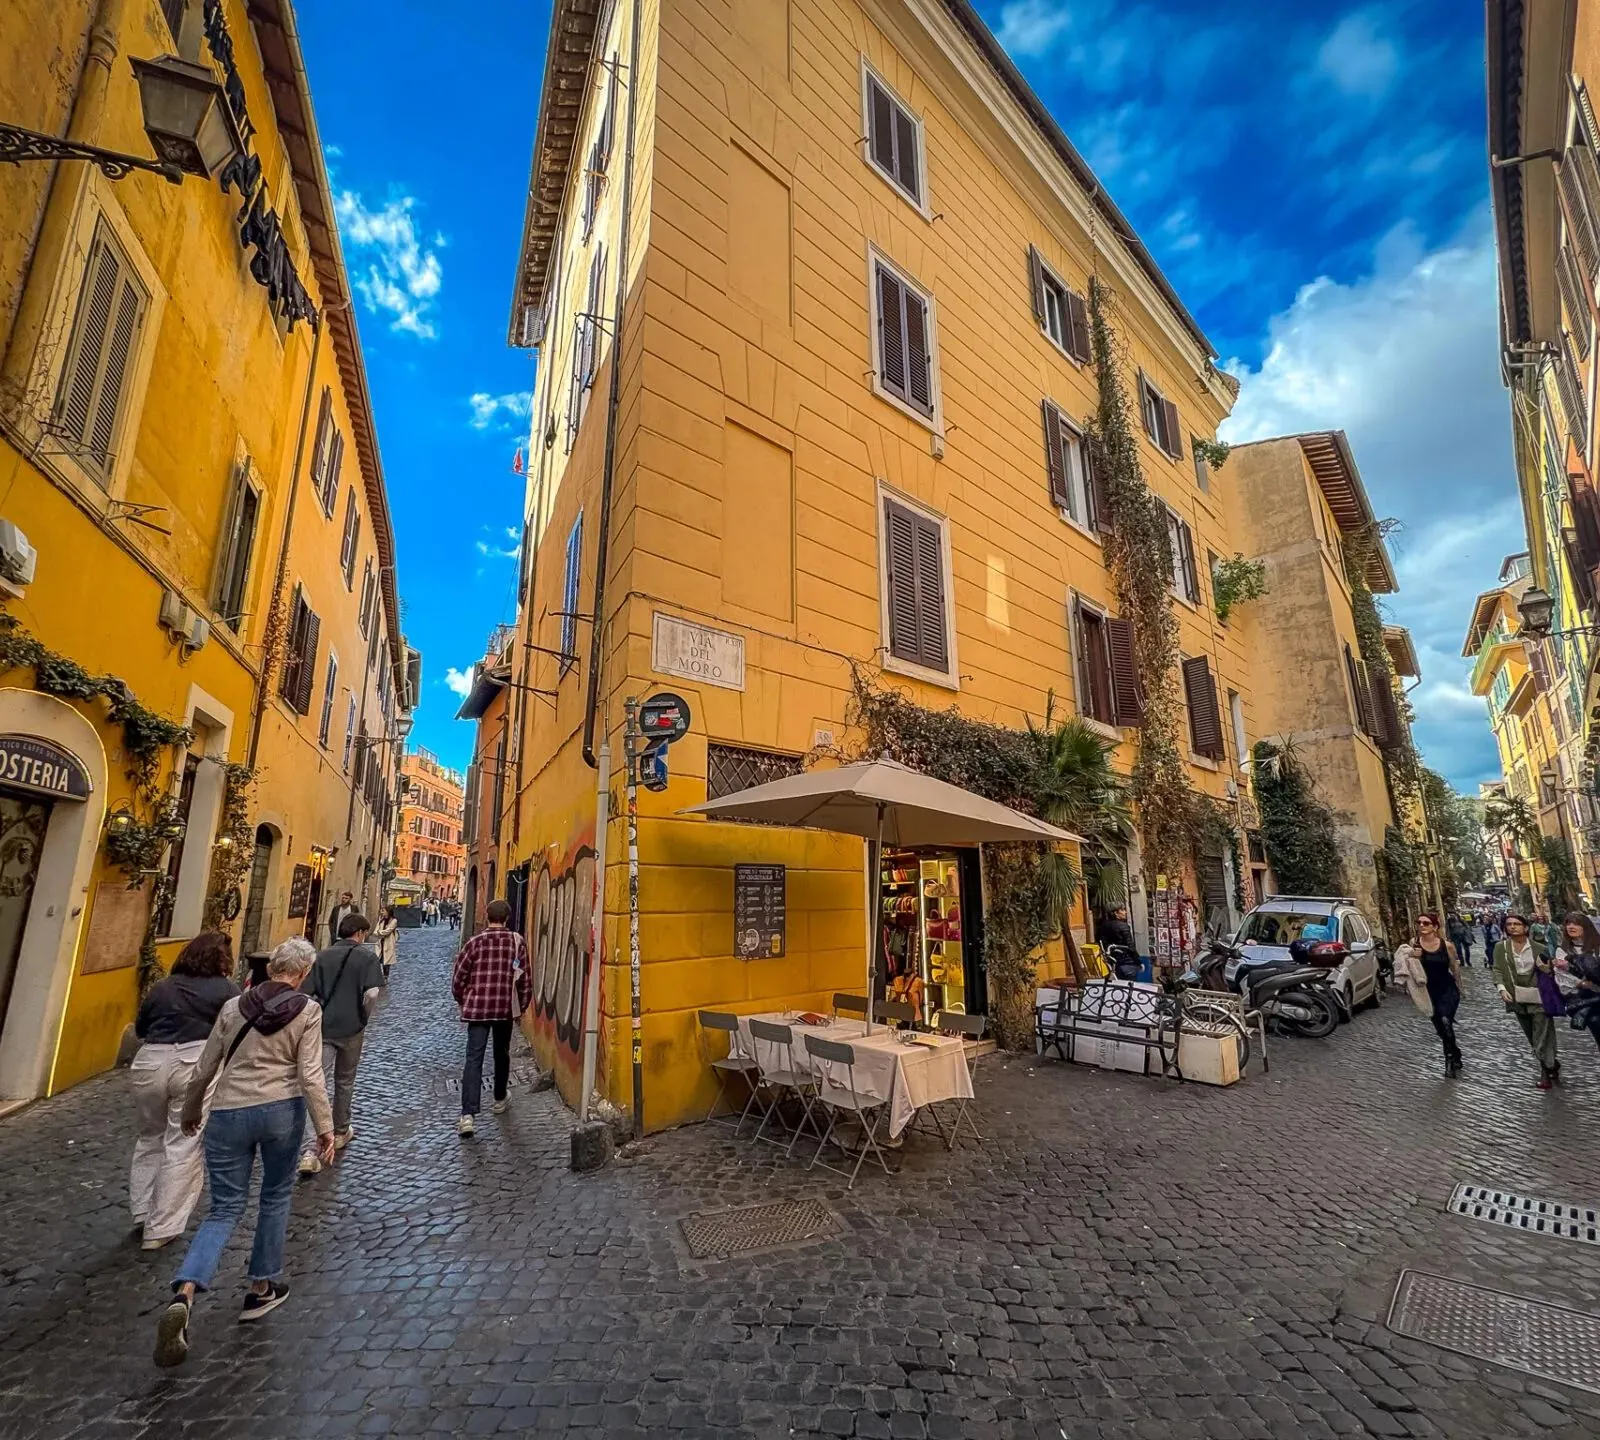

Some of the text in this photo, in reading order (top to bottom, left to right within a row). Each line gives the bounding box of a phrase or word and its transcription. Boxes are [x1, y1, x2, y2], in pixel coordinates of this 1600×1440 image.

[689, 631, 714, 649] VIA
[690, 646, 712, 661] DEL
[678, 656, 721, 677] MORO
[0, 749, 68, 792] OSTERIA
